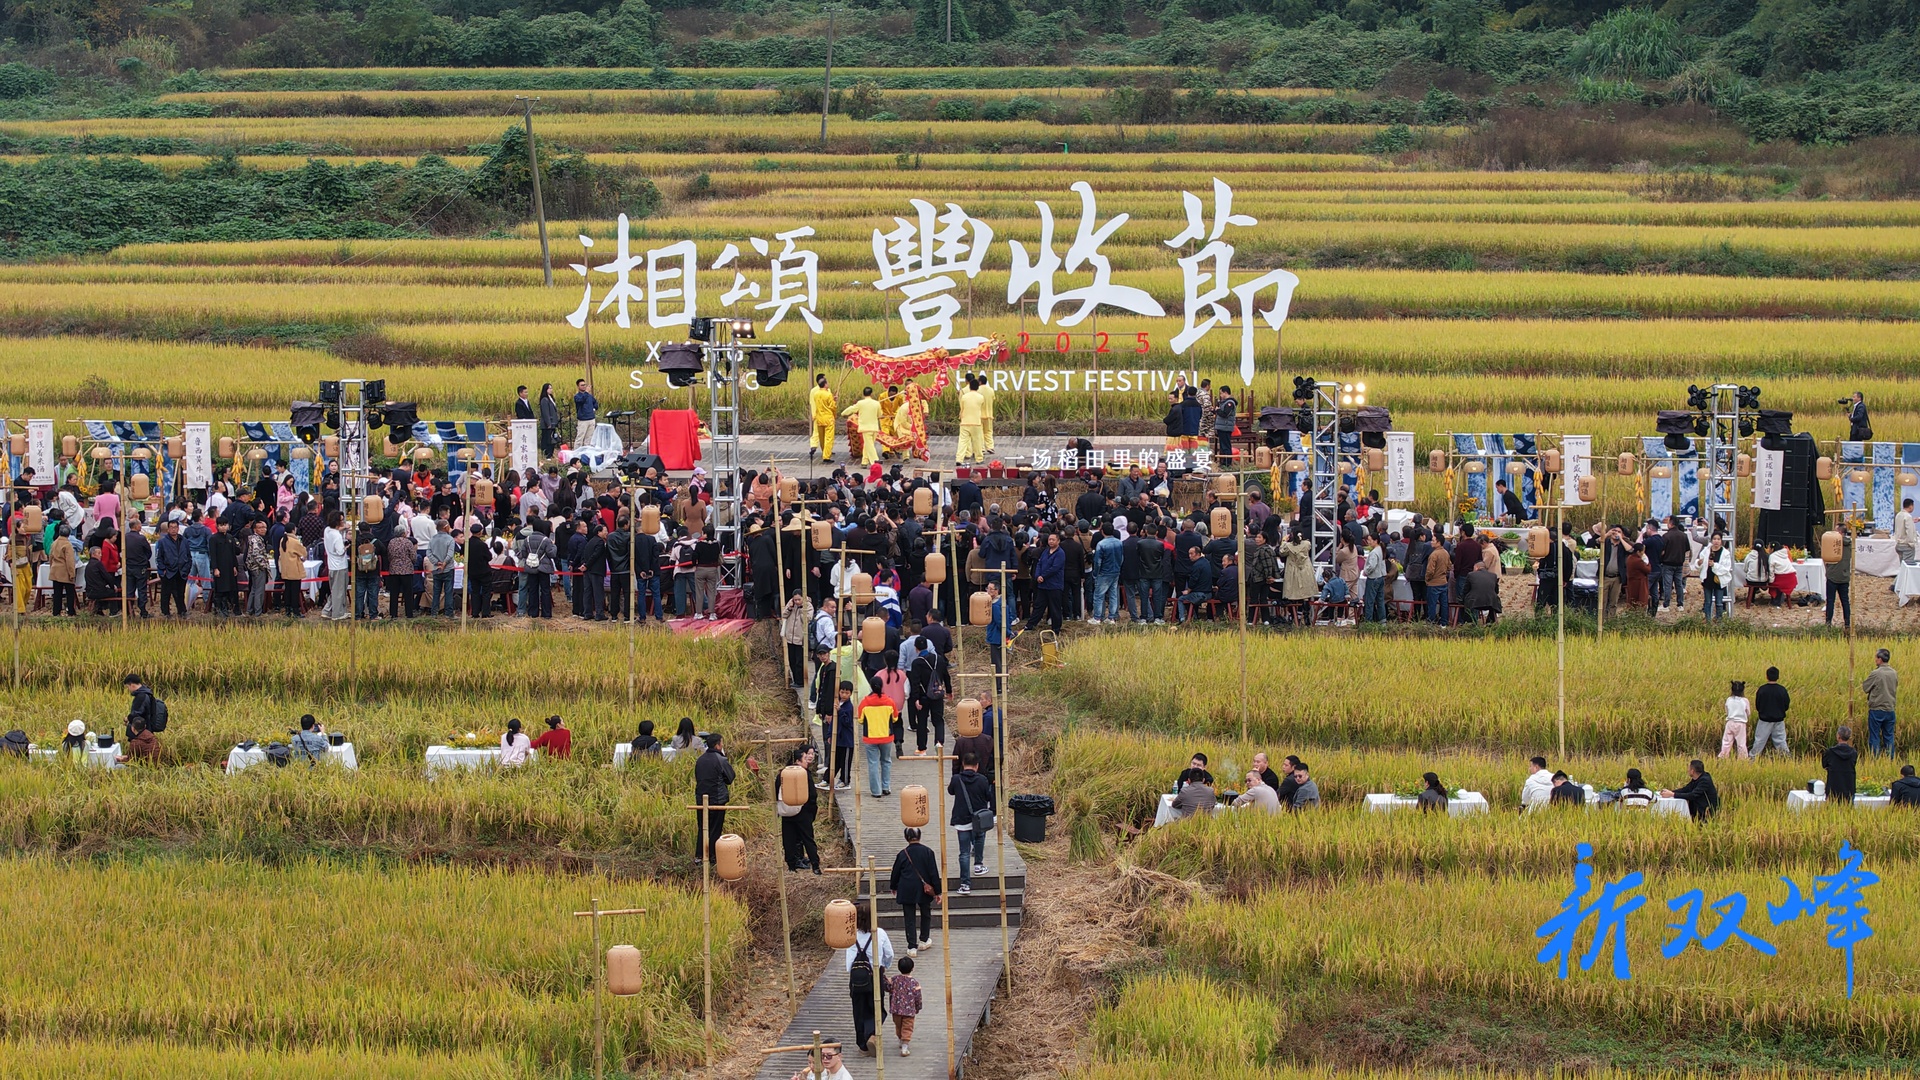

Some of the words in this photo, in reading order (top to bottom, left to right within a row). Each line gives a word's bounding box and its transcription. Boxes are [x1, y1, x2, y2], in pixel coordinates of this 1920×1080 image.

[566, 213, 823, 333] 湘頌
[872, 177, 1299, 386] 豐收節
[646, 341, 744, 362] XNG
[1017, 332, 1150, 353] 2025
[629, 370, 760, 391] SNG
[1004, 448, 1213, 471] 一场稻田里的盛宴
